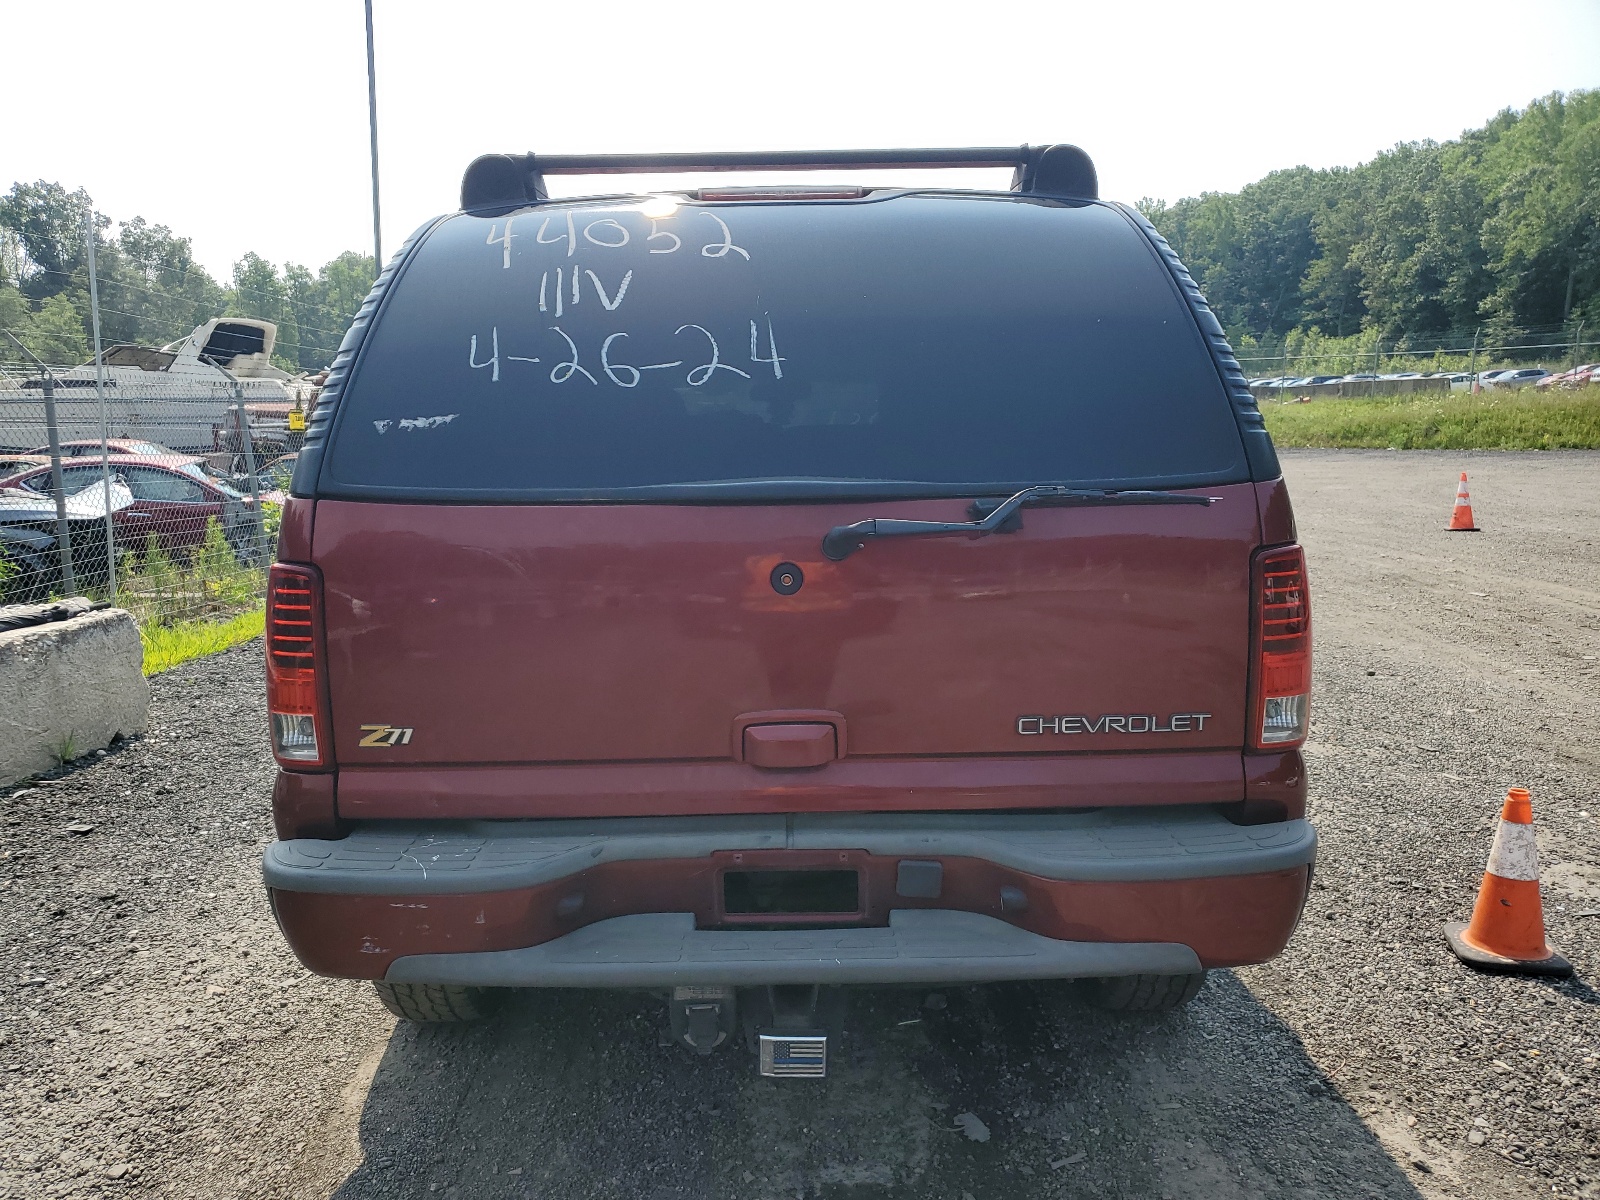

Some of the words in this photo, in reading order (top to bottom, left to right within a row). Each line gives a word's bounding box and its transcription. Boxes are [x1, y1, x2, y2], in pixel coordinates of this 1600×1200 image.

[486, 211, 750, 269] 44052
[469, 313, 787, 388] 4-26-24
[359, 725, 413, 747] Z71
[1017, 713, 1212, 735] CHEVROLET
